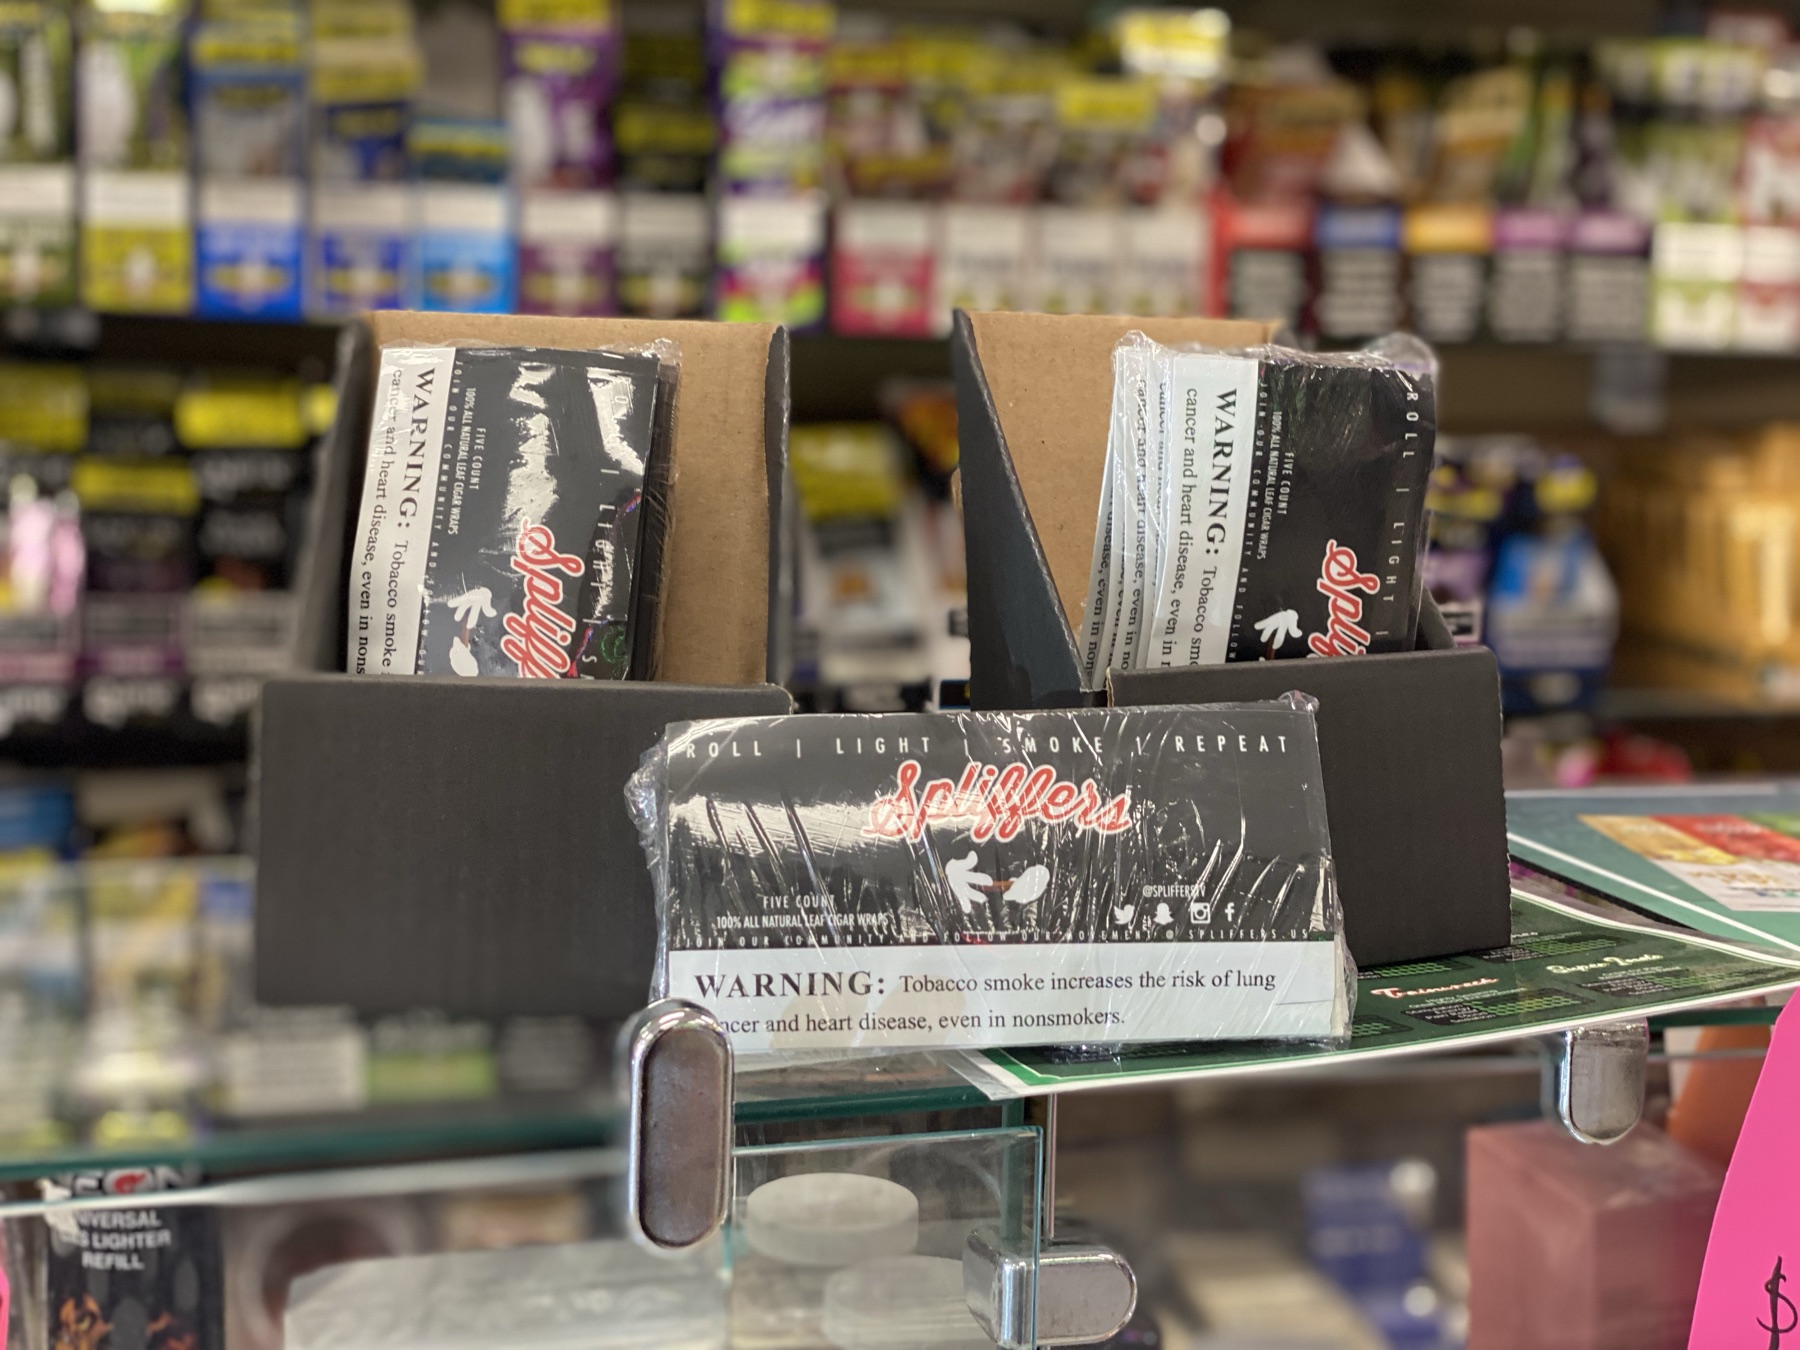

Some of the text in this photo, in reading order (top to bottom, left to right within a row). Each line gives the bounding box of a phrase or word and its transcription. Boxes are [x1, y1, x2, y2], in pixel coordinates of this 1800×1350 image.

[389, 369, 402, 422] cancer
[451, 361, 464, 394] JOIN
[446, 405, 457, 431] OUR
[1184, 387, 1198, 444] cancer
[1403, 391, 1419, 459] ROLL
[384, 426, 398, 455] and
[469, 427, 487, 490] FIVE COUNT
[376, 460, 395, 499] heart
[447, 387, 477, 535] 100% ALL NATURAL LEAF CIGAR WRAPS
[1182, 448, 1197, 478] and
[1205, 388, 1238, 555] WARNING:
[433, 443, 453, 530] COMMUNITY
[1256, 411, 1283, 560] 100% ALL NATURAL LEAF CIGAR WRAPS
[1277, 452, 1295, 515] FIVE COUNT
[382, 367, 436, 667] WARNING: Tobacco smoke
[1180, 483, 1197, 526] heart
[1228, 381, 1268, 659] JOIN OUR COMMUNITY AND FOLLOW
[361, 504, 387, 566] disease,
[428, 541, 440, 568] AND
[1170, 529, 1194, 595] disease,
[1383, 521, 1405, 602] LIGHT
[360, 570, 372, 610] even
[1093, 577, 1107, 616] even
[1128, 587, 1141, 626] even
[1193, 566, 1218, 633] Tobacco
[359, 614, 373, 631] in
[1090, 621, 1105, 636] in
[1164, 596, 1182, 636] even
[1124, 630, 1137, 646] in
[1162, 639, 1178, 656] in
[686, 741, 762, 758] ROLL
[836, 737, 930, 754] LIGHT
[1003, 736, 1103, 754] SMOKE
[1175, 735, 1287, 753] REPEAT
[861, 760, 1133, 843] Spliffers
[716, 915, 742, 929] 100%
[743, 915, 760, 928] ALL
[762, 914, 802, 928] NATURAL
[804, 913, 827, 927] LEAF
[857, 911, 889, 926] WRAPS
[763, 894, 835, 909] FIVE COUNT
[686, 935, 724, 948] JOIN
[739, 935, 769, 947] OUR
[1022, 930, 1051, 942] OUR
[1188, 929, 1277, 941] SPLIFFERS
[694, 969, 1276, 999] WARNING: Tobacco smoke increases the risk of lung
[765, 1013, 800, 1032] and
[805, 1013, 853, 1032] heart
[858, 1011, 933, 1032] disease,
[938, 1014, 981, 1029] even
[988, 1010, 1006, 1028] in
[1012, 1008, 1125, 1028] nonsmokers.
[91, 1229, 172, 1250] LIGHTER
[81, 1251, 145, 1270] REFILL
